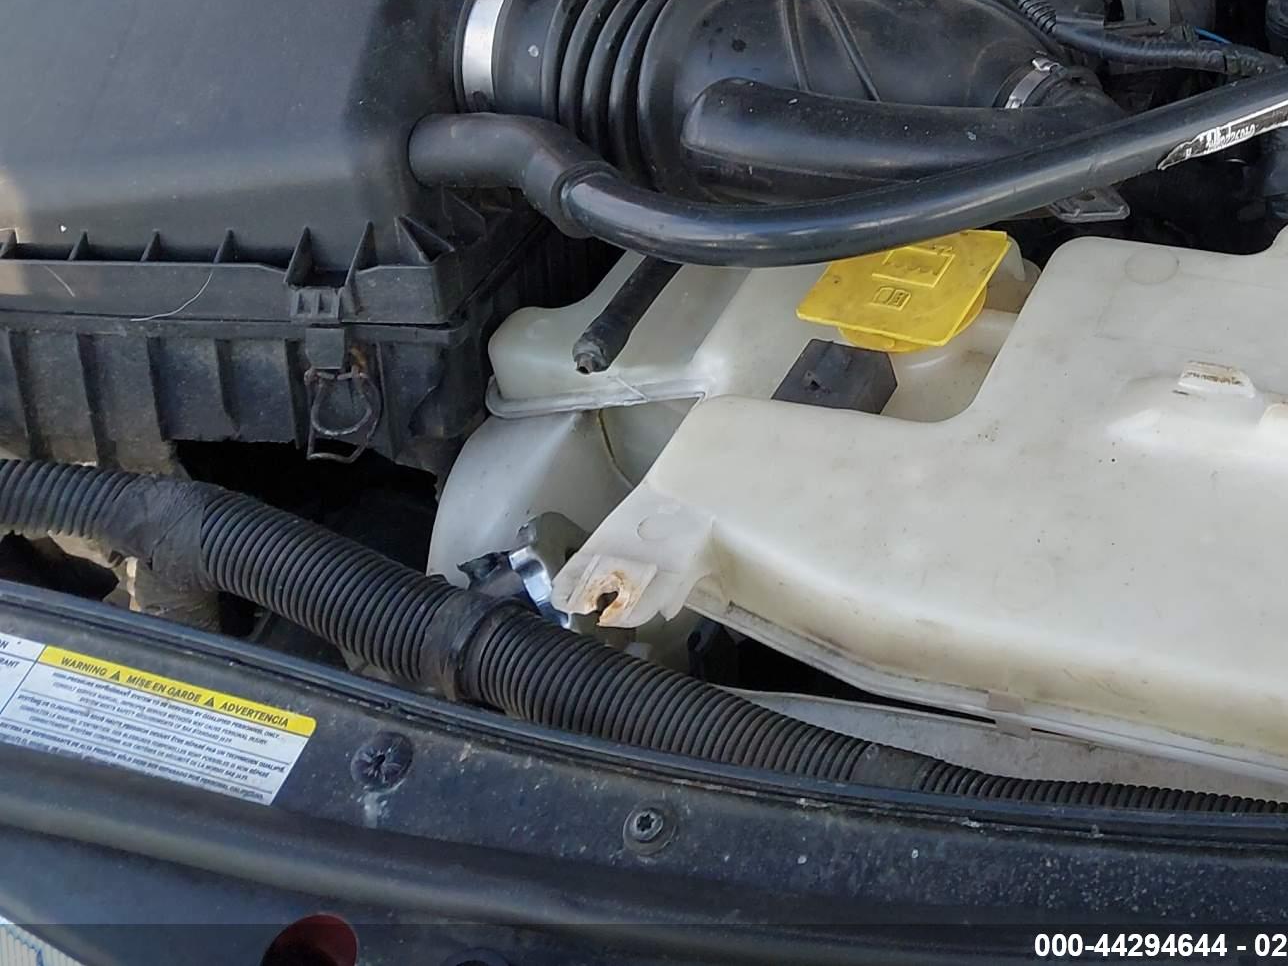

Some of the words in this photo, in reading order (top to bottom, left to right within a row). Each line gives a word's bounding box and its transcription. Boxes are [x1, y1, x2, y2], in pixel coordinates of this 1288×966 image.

[60, 656, 108, 677] WARNING
[152, 682, 166, 693] EN
[167, 686, 203, 702] GARDE
[219, 701, 290, 728] ADVERTENCIA
